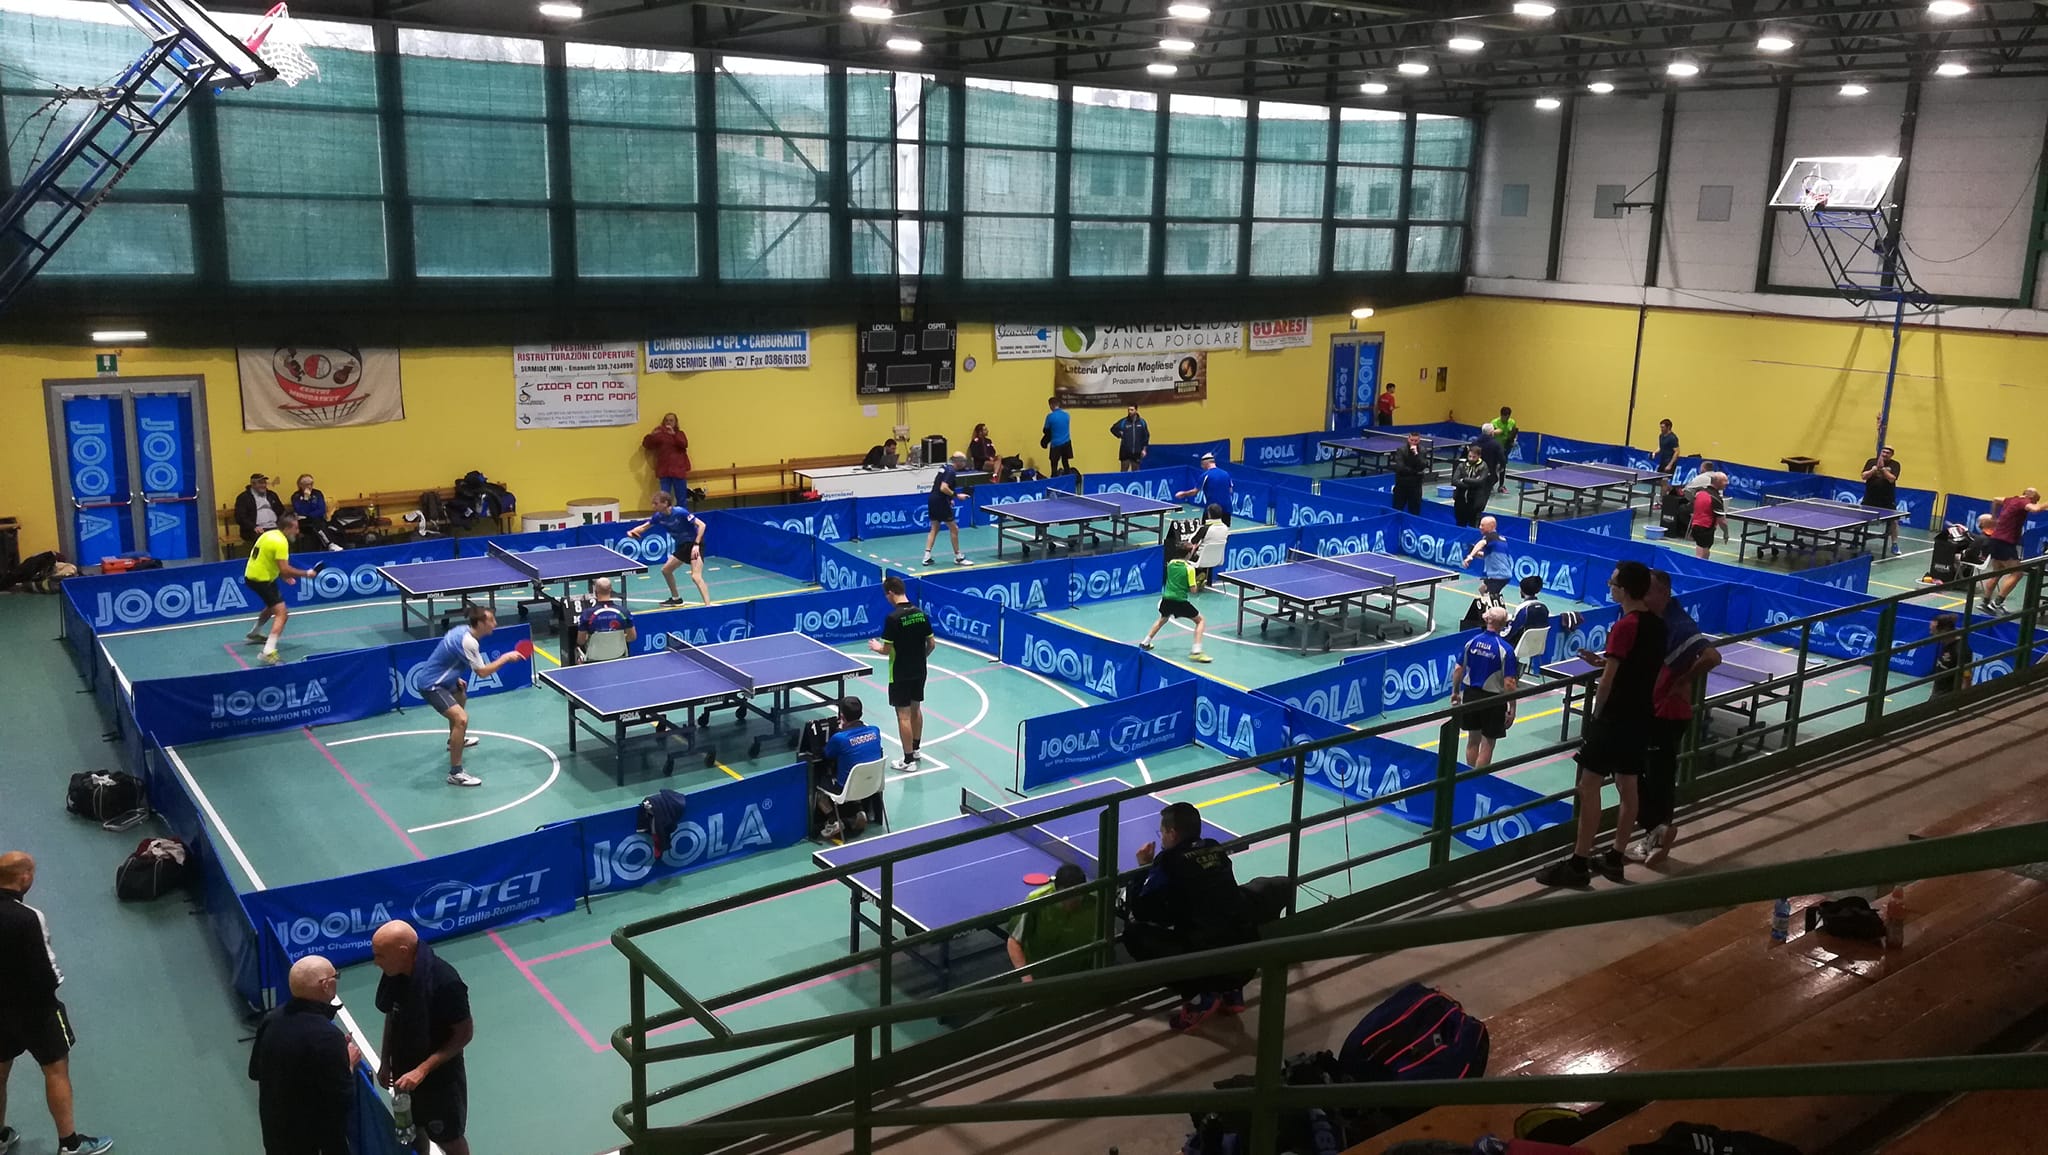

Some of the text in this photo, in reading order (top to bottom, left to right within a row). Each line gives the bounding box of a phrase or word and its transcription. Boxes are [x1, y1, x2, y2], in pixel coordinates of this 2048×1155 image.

[517, 350, 636, 361] RISTRUTTURAZIONI COPERTURE
[653, 334, 802, 351] COMBUSTIBILI GPL CARBURANTI
[1103, 336, 1155, 350] BANCA
[1165, 332, 1239, 347] POPOLARE
[520, 365, 547, 373] SERMIDE
[649, 357, 674, 370] 46028
[675, 356, 708, 369] SERMIDE
[709, 355, 727, 369] (MN)
[750, 354, 763, 366] Fax
[1101, 362, 1136, 377] Agricola
[537, 381, 625, 391] GIOCA CON NOI
[576, 393, 605, 402] PING
[608, 392, 637, 401] PONG
[1260, 444, 1295, 460] JOOLA
[70, 420, 113, 542] JOOLA
[141, 417, 181, 537] JOOLA
[865, 511, 907, 526] JOOLA
[1401, 527, 1466, 568] OOLA
[1068, 564, 1146, 603] OOLA
[96, 576, 248, 628] JOOLA
[793, 604, 869, 633] JOOLA
[946, 612, 992, 637] FITET
[1022, 633, 1119, 698] JOOLA
[1383, 654, 1456, 706] OOLA
[211, 678, 329, 719] JOOLA
[251, 711, 300, 726] CHAMPION
[301, 708, 312, 718] IN
[313, 705, 331, 715] YOU
[619, 711, 641, 721] JOOLA
[1118, 711, 1183, 745] FITET
[1039, 730, 1100, 761] JOOLA
[589, 803, 773, 890] JOOLA
[433, 868, 551, 921] FITET
[277, 902, 392, 947] JOOLA
[457, 896, 541, 928] Emilia-Romagna
[308, 945, 325, 955] the
[327, 939, 373, 951] Champio
